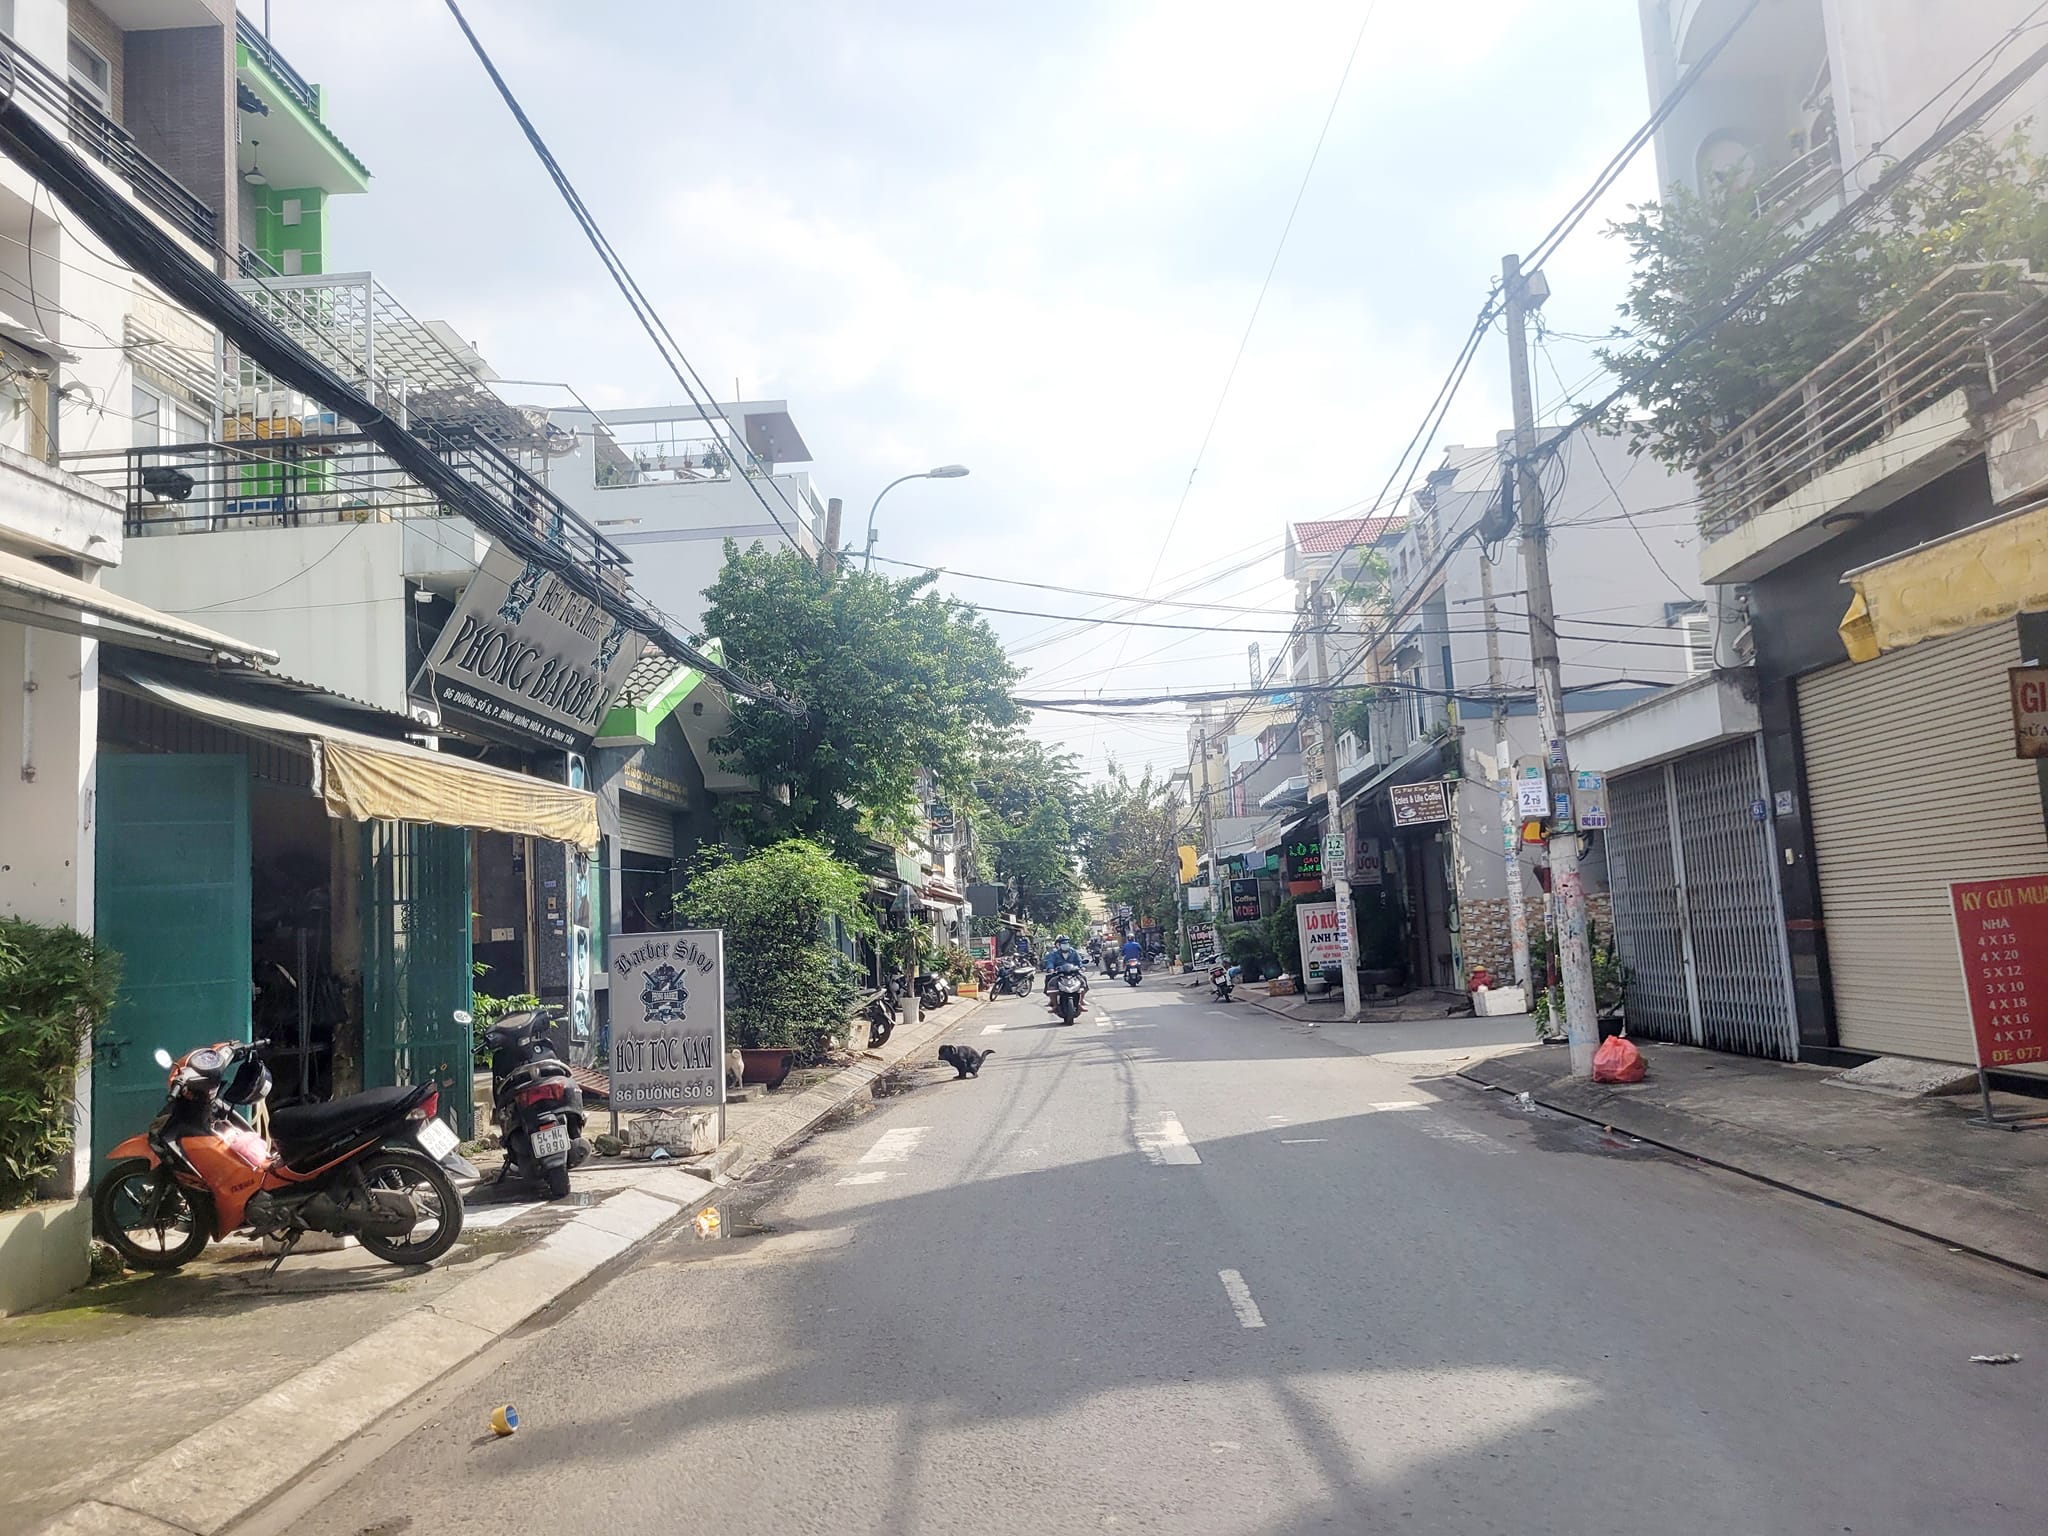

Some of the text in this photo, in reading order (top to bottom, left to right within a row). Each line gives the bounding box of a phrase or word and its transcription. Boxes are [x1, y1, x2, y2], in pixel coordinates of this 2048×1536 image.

[438, 614, 611, 727] PHONG BARBER
[443, 688, 453, 699] 86
[476, 698, 490, 711] SỐ
[1523, 793, 1531, 806] 2
[1310, 933, 1331, 943] ANH
[1978, 934, 2016, 947] 4 X 15
[614, 938, 714, 981] Barber Shop
[1981, 950, 2019, 963] 4 X 20
[1983, 965, 2022, 979] 5 X 12
[1986, 981, 2025, 994] 3 X 10
[1989, 997, 2027, 1010] 4 X 18
[1992, 1013, 2030, 1026] 4 X 16
[1994, 1029, 2032, 1042] 4 X 17
[615, 1030, 713, 1073] HỚT TÓC NAM
[2017, 1047, 2042, 1059] 077
[615, 1081, 714, 1102] 86 ĐƯỜNG SỐ 8
[540, 1139, 565, 1155] 6890
